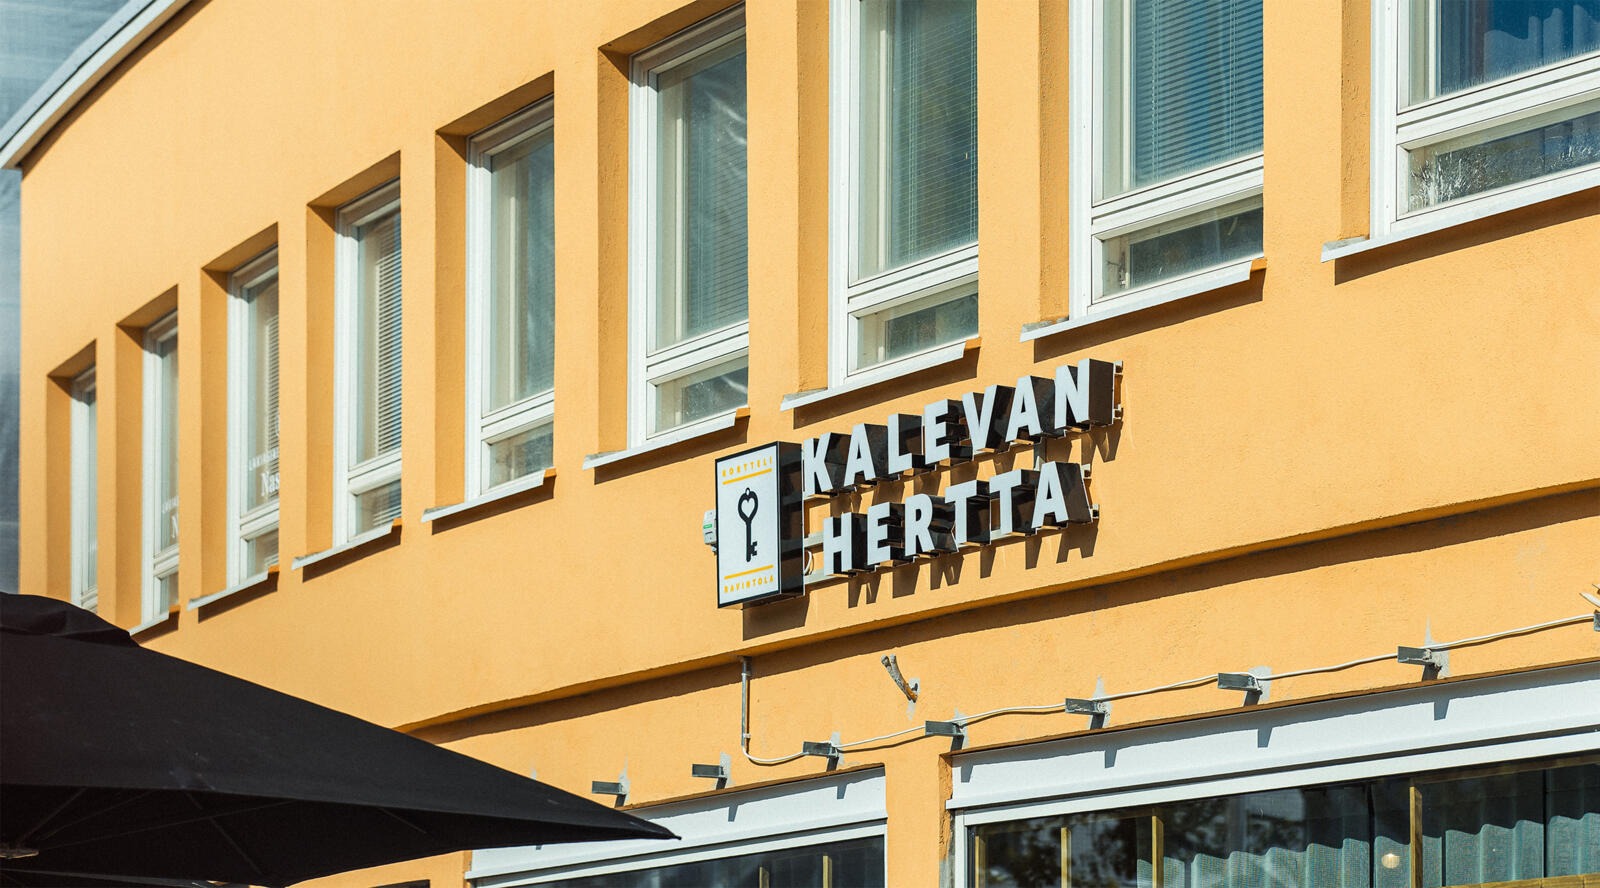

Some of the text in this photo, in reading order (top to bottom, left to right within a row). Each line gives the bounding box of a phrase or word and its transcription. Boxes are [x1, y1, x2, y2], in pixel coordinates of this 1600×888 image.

[803, 359, 1091, 498] KALEVAN
[823, 461, 1069, 577] HERTTA
[724, 574, 774, 593] RAVINTOLA
